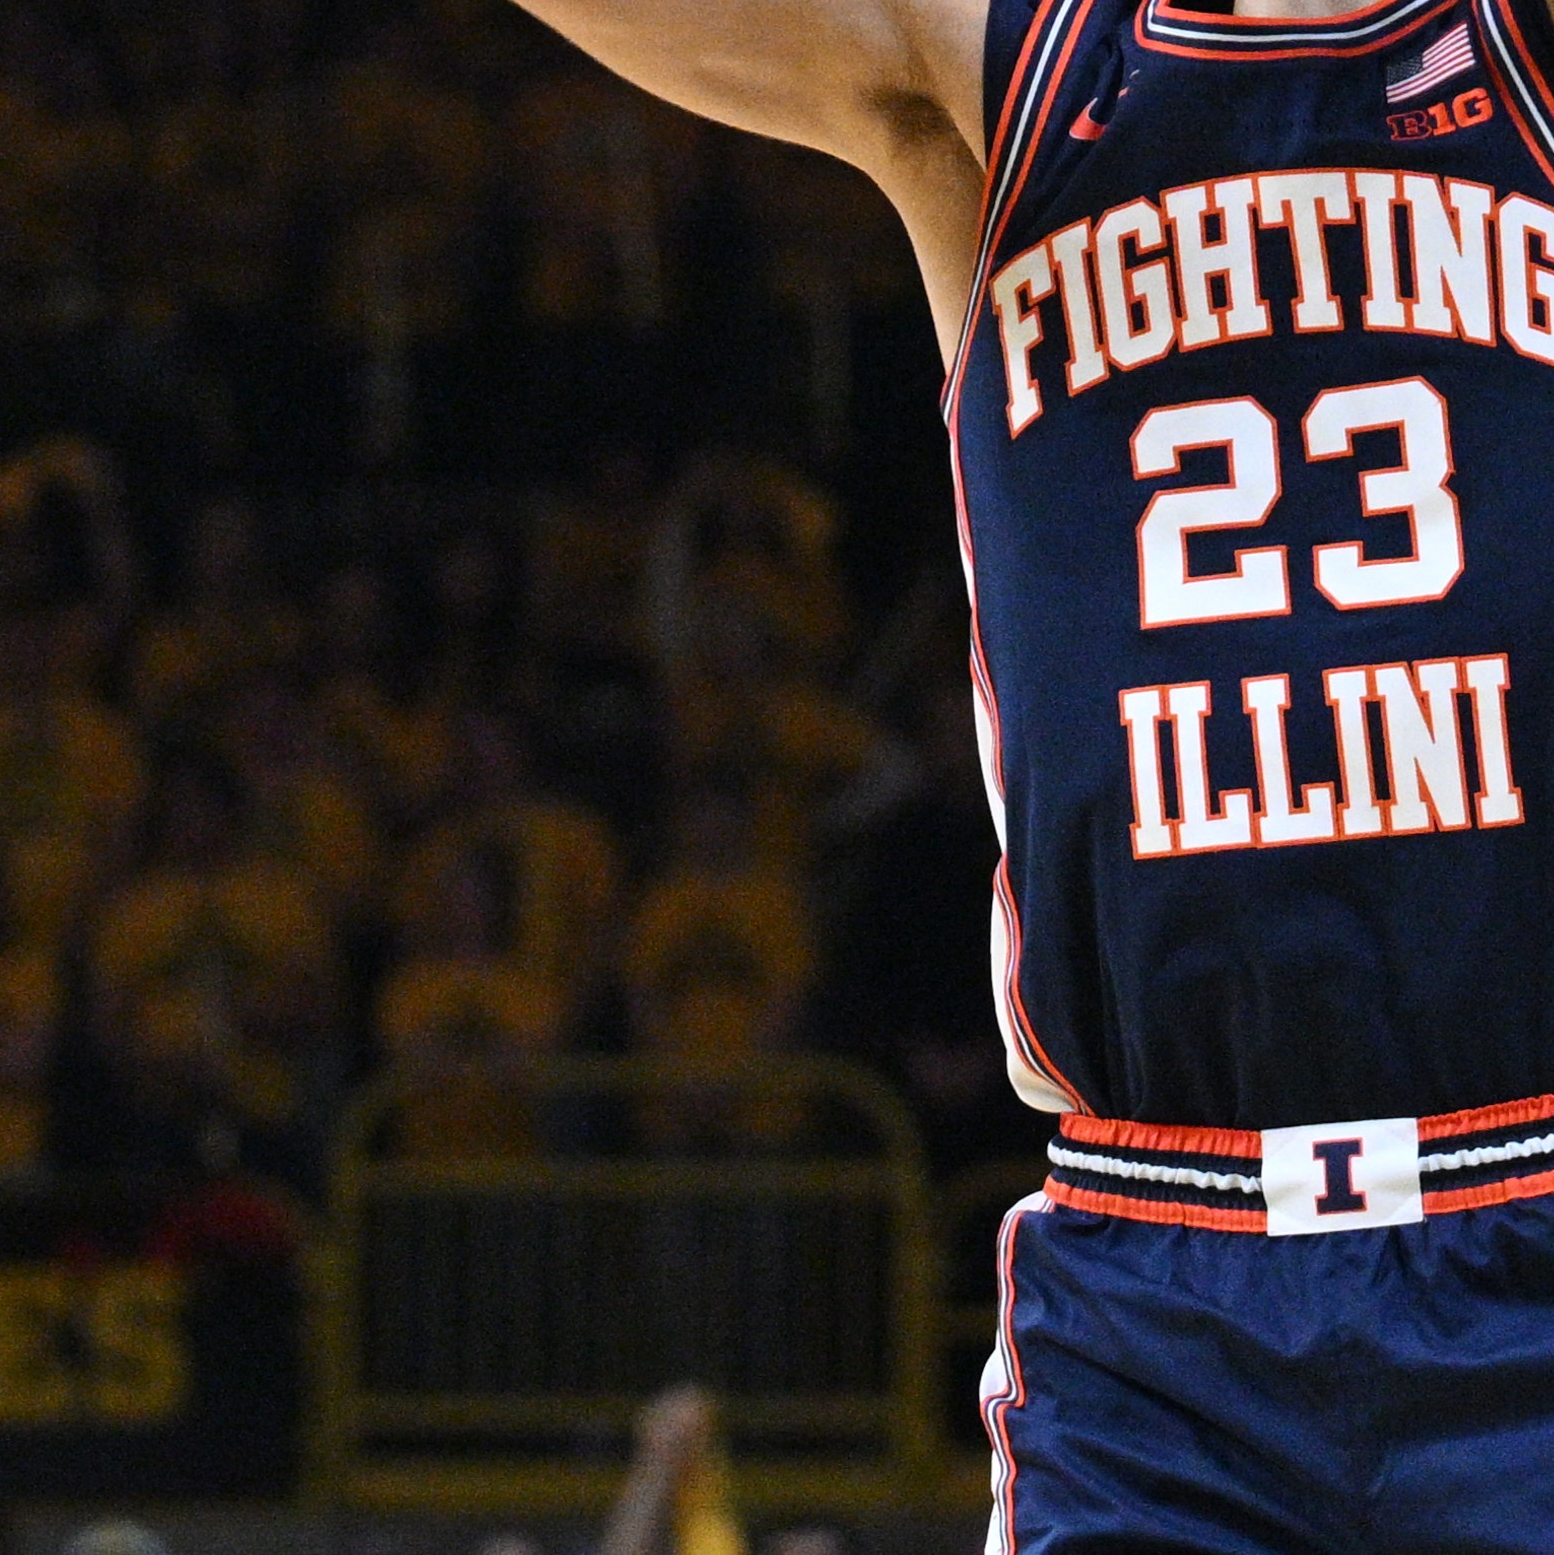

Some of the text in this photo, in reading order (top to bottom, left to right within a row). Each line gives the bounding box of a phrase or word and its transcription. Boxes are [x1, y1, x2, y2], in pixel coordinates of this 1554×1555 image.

[1129, 375, 1466, 631] 23
[1118, 652, 1526, 860] ILLINI
[1312, 1137, 1369, 1214] I
